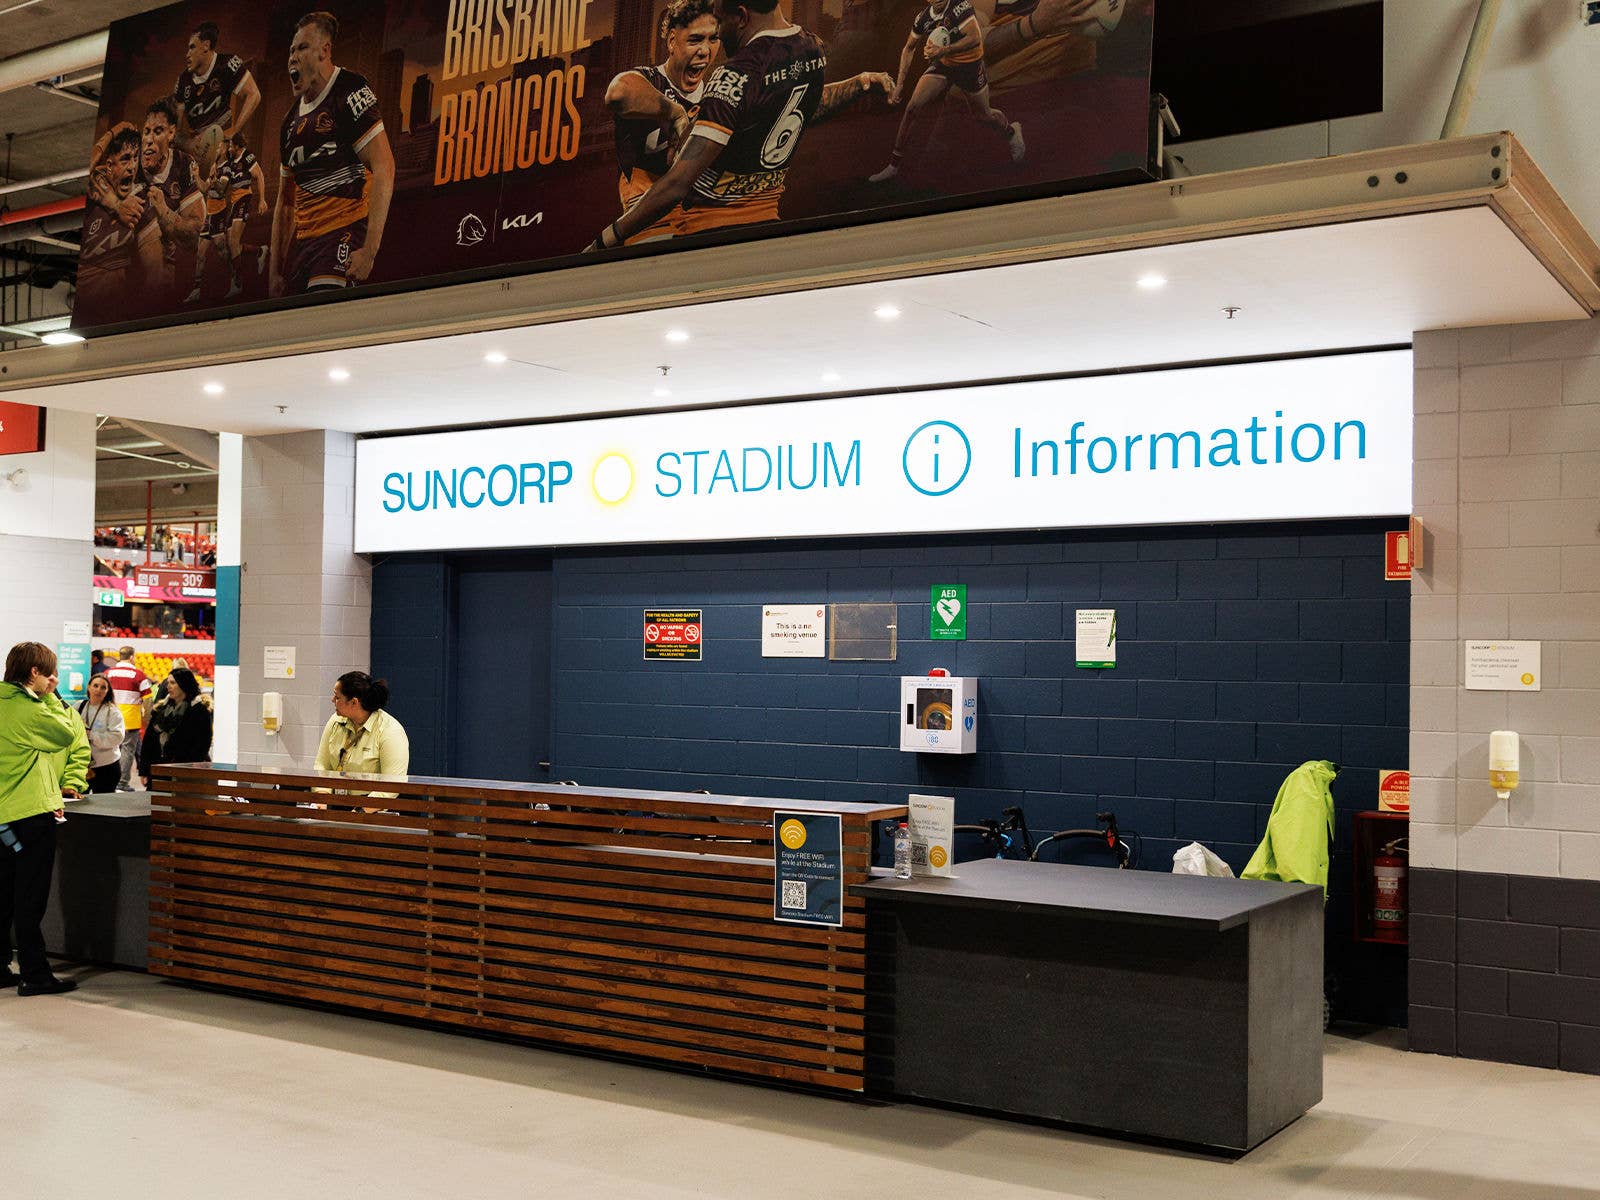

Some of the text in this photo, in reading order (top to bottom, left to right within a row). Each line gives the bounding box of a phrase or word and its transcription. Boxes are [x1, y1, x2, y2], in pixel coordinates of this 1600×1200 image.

[442, 0, 593, 81] BRISBANE
[709, 65, 749, 88] first
[764, 69, 787, 86] THE
[703, 79, 743, 102] mac
[433, 64, 586, 186] BRONCOS
[760, 83, 809, 169] 6
[382, 460, 573, 513] SUNCORP
[655, 439, 861, 498] STADIUM
[1013, 410, 1367, 478] Information
[182, 573, 203, 587] 309
[940, 589, 957, 598] AED
[770, 631, 797, 639] smoking
[964, 698, 976, 708] AED
[781, 851, 797, 861] Enjoy
[797, 852, 811, 860] FREE
